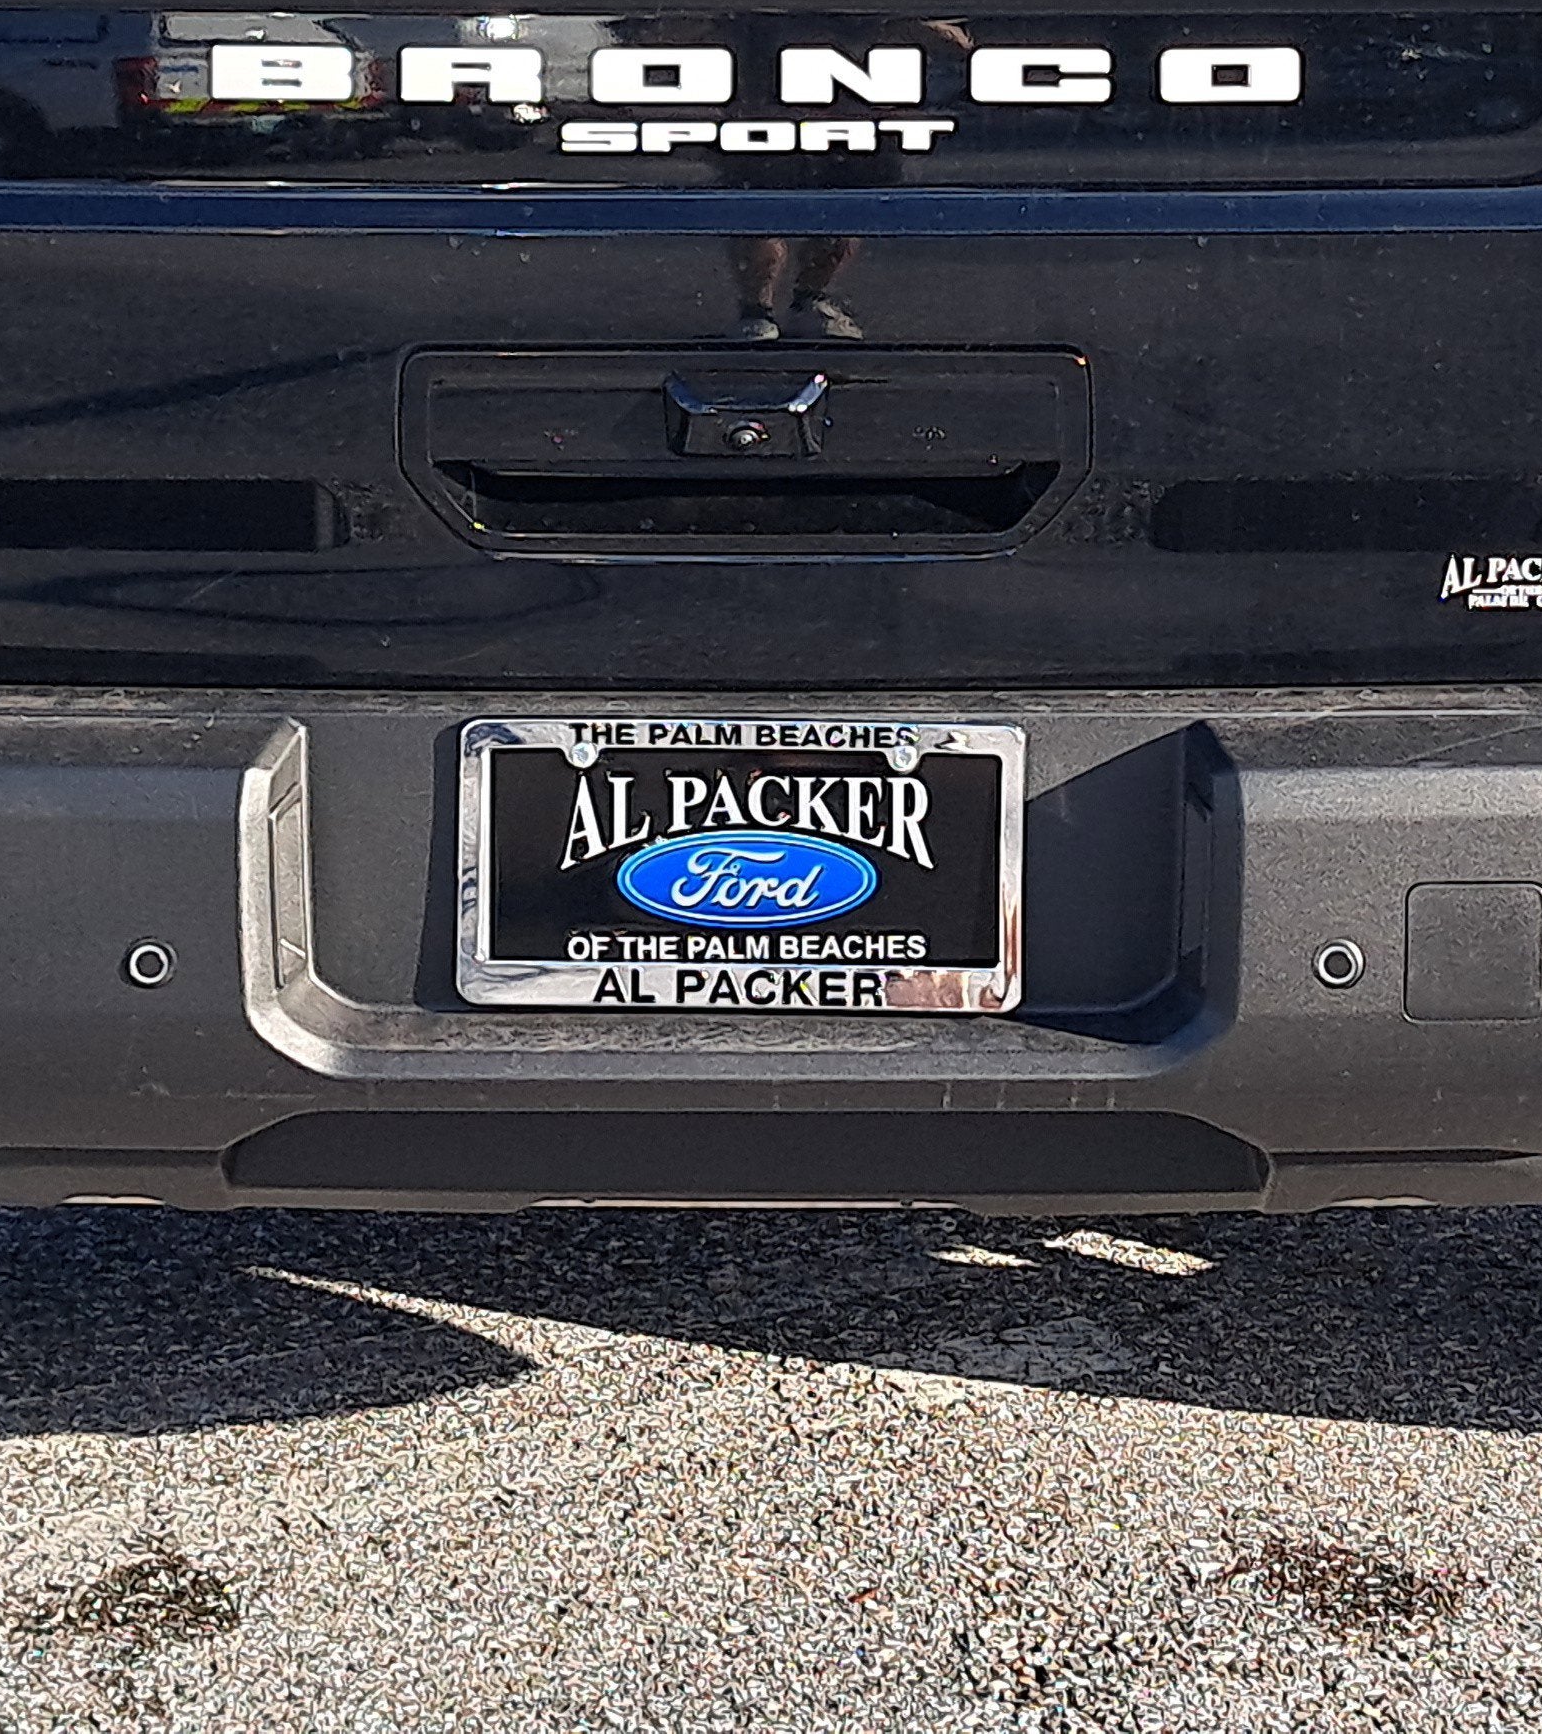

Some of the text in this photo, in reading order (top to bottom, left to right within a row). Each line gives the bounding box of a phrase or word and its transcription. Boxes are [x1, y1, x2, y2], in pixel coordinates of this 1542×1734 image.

[209, 45, 1303, 104] BRONCO
[560, 119, 957, 153] SPORT
[1440, 554, 1482, 599] AL
[569, 723, 920, 748] THE PALM BEACHES
[560, 775, 934, 870] AL PACKER
[670, 847, 825, 908] Ford
[568, 934, 927, 960] OF THE PALM BEACHES
[593, 968, 883, 1007] AL PACKER
